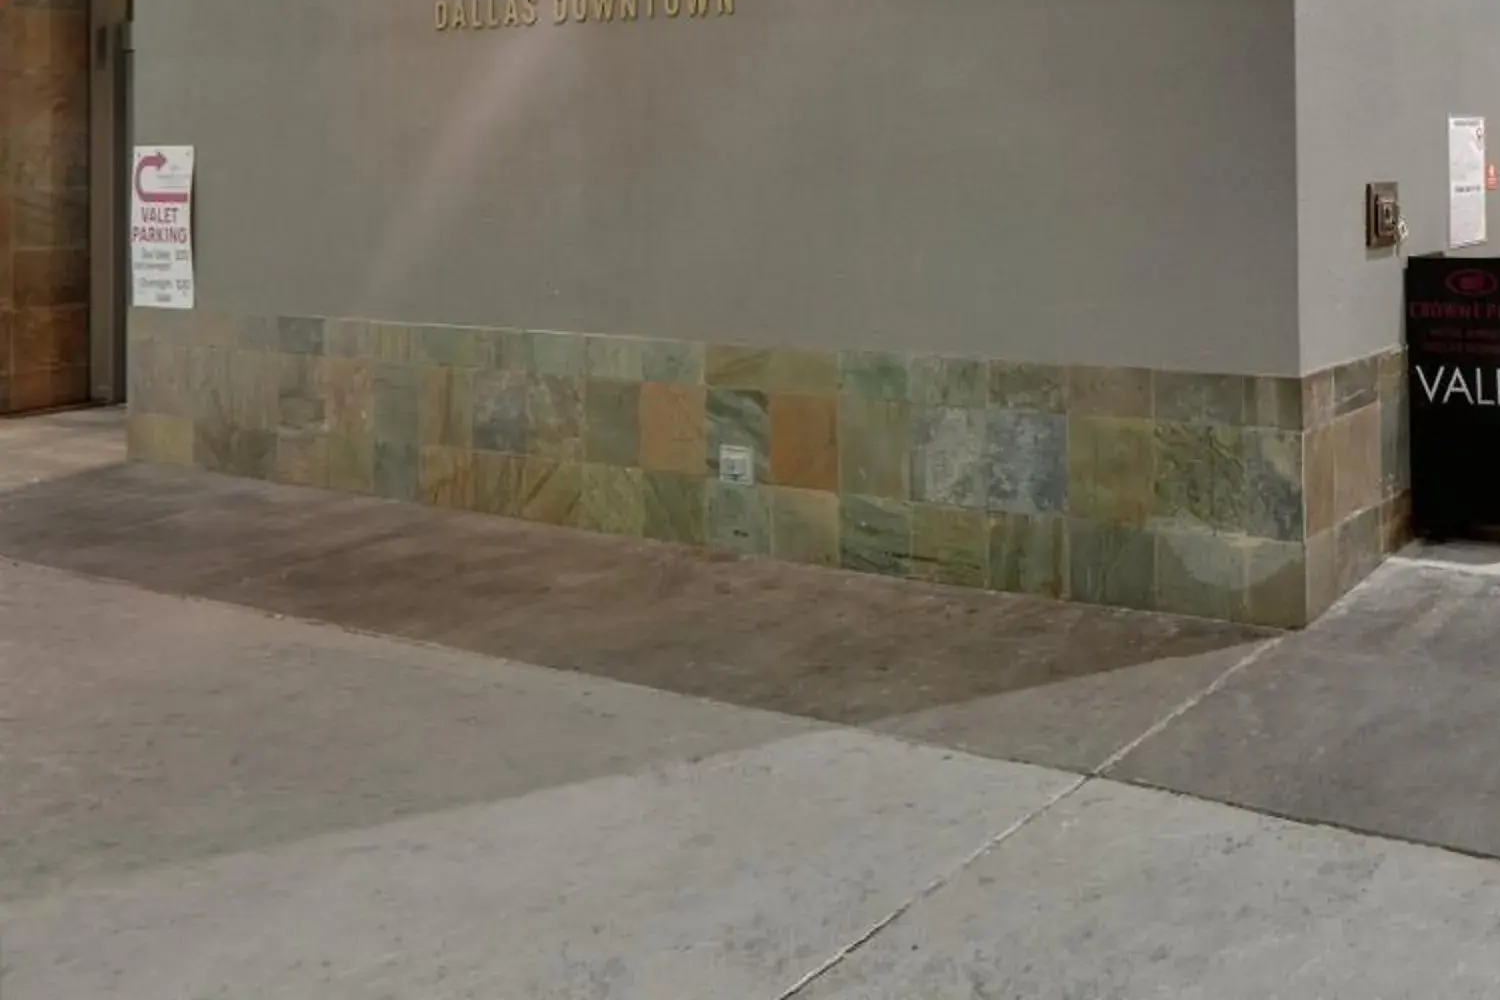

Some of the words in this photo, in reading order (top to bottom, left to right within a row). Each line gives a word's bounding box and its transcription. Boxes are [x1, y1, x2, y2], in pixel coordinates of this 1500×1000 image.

[140, 207, 179, 223] VALET
[133, 226, 187, 244] PARKING
[1409, 301, 1479, 319] CROWNE
